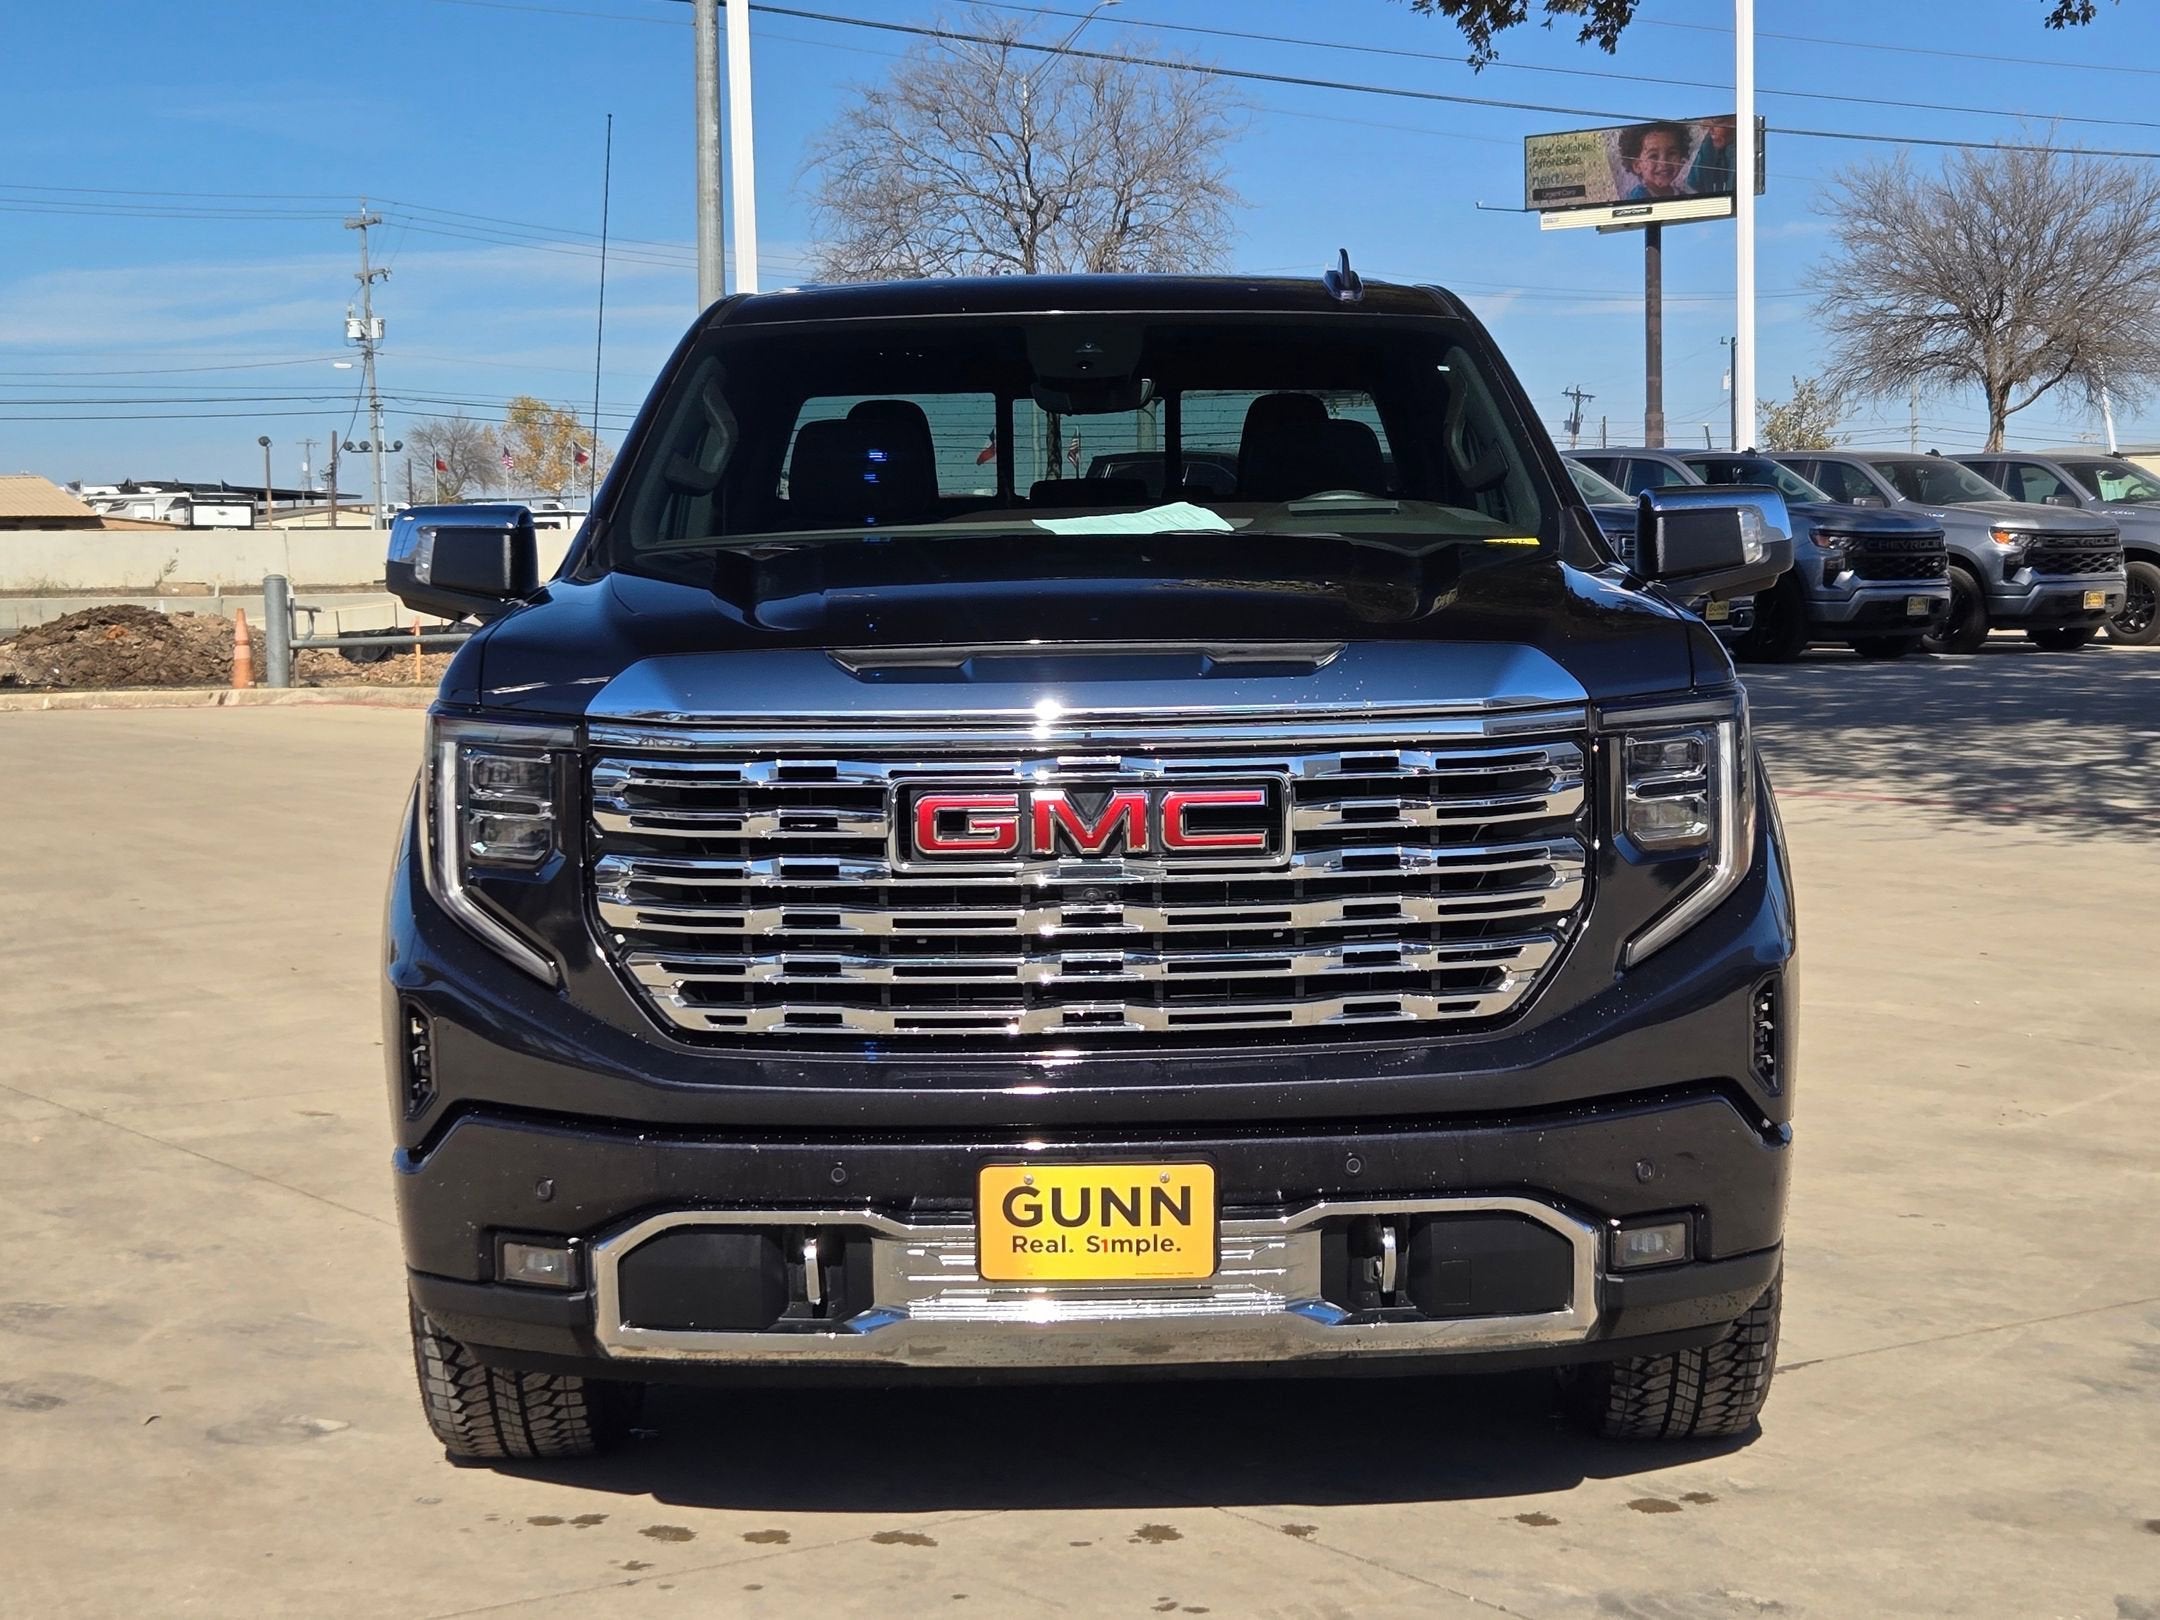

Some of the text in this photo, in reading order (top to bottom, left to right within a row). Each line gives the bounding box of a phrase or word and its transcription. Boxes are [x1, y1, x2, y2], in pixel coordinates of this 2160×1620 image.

[914, 788, 1268, 855] GMC
[1002, 1186, 1191, 1228] GUNN
[1012, 1235, 1074, 1253] Real.
